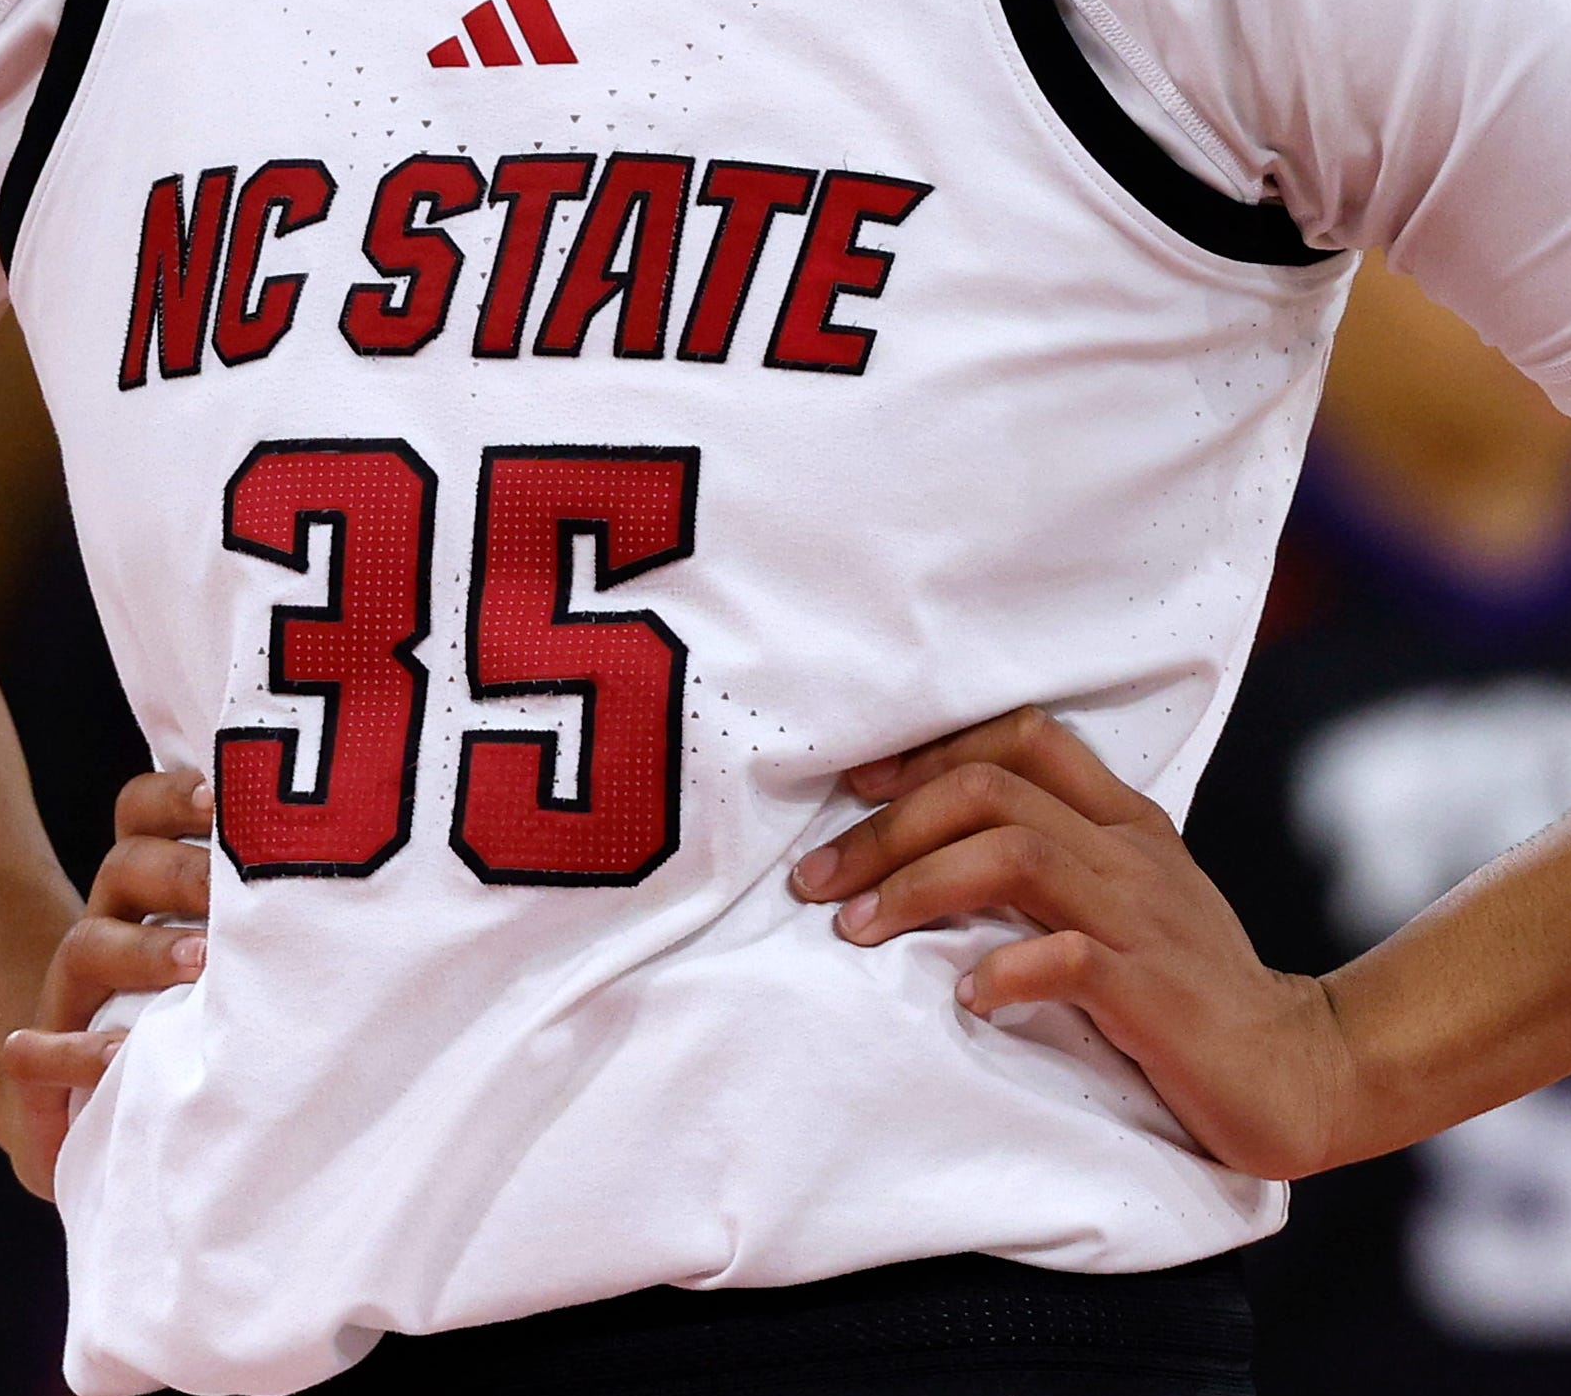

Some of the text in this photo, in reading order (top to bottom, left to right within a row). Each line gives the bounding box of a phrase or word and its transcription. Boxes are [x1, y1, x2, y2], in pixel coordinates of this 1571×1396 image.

[118, 152, 934, 392] NC STATE
[214, 437, 700, 887] 35
